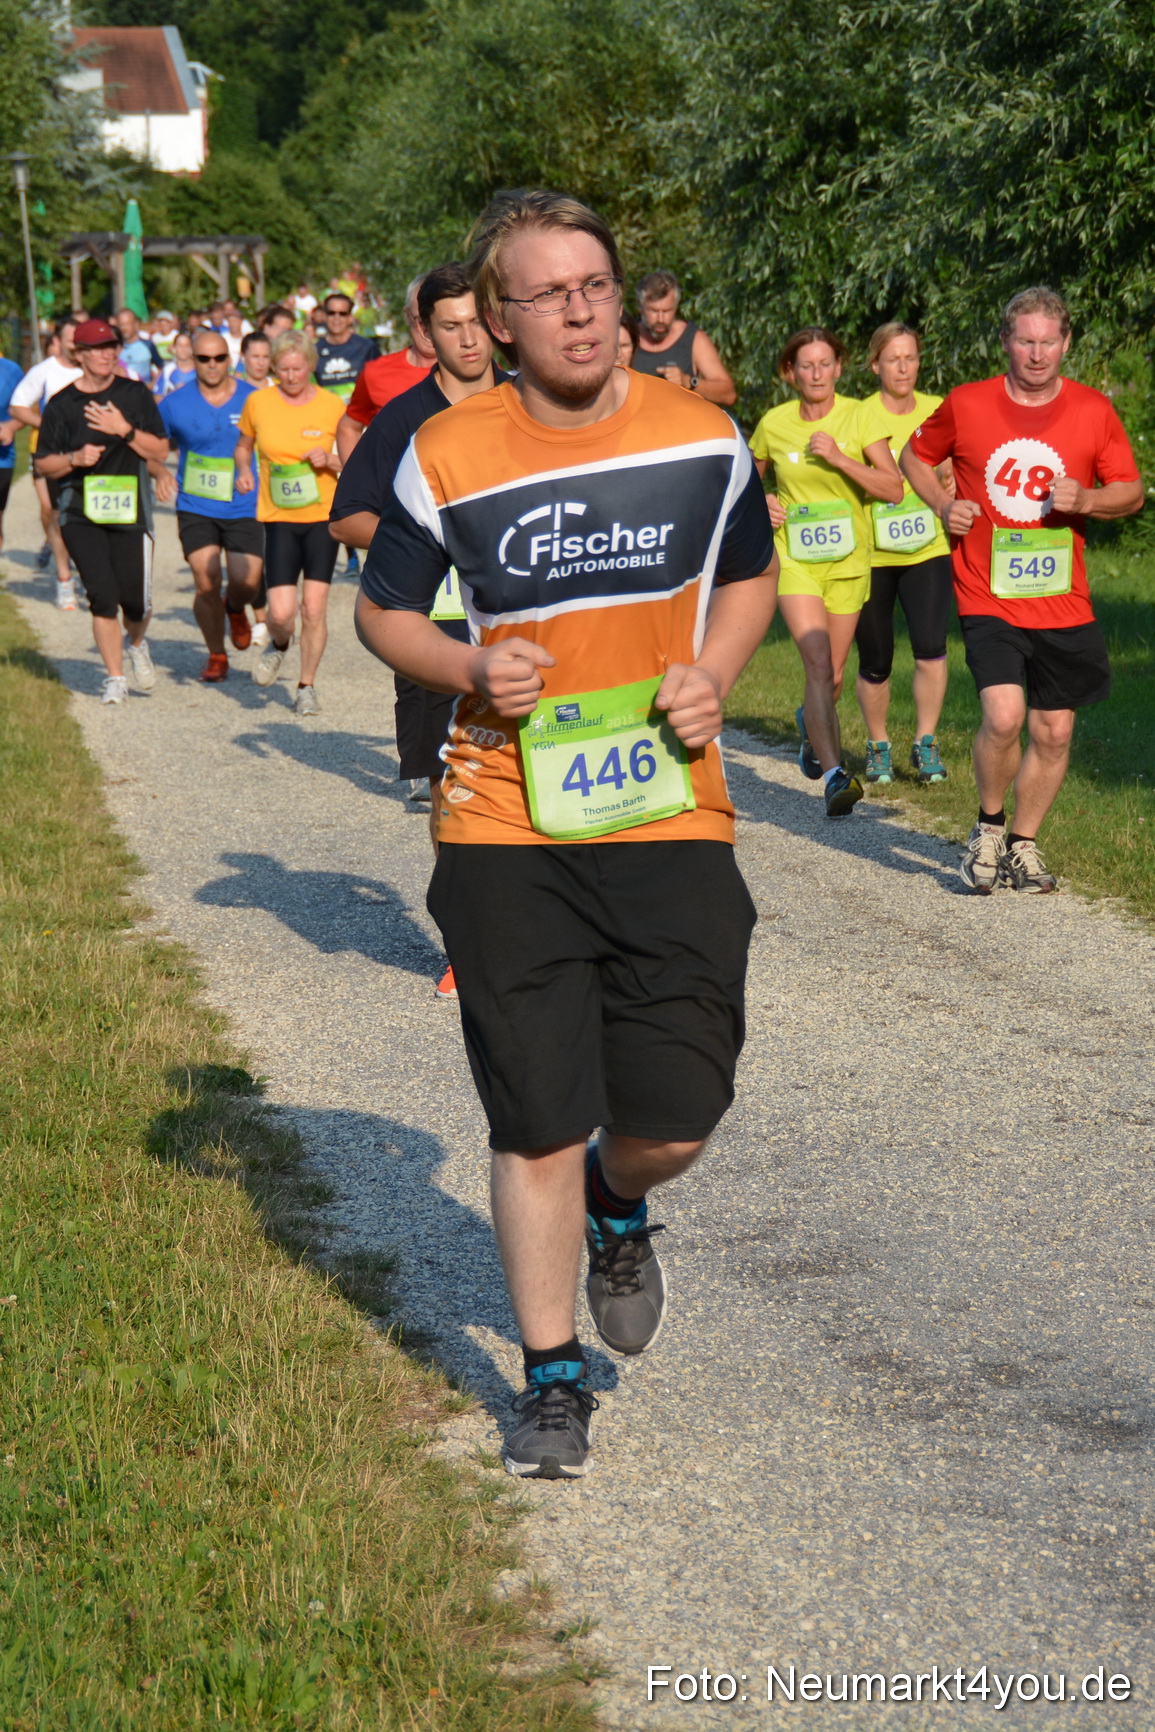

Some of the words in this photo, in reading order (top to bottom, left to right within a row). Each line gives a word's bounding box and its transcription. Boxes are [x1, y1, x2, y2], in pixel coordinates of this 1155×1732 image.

[199, 473, 218, 488] 18
[281, 481, 303, 496] 64
[993, 457, 1055, 502] 48
[92, 495, 132, 510] 1214
[800, 524, 842, 547] 665
[888, 516, 926, 540] 666
[530, 522, 675, 566] Fischer
[546, 552, 666, 580] AUTOMOBILE
[1008, 556, 1056, 579] 549
[546, 714, 604, 733] firmenlauf
[561, 739, 657, 798] 446
[582, 803, 621, 817] Thomas
[622, 794, 646, 809] Barth
[544, 1364, 565, 1375] NIKE
